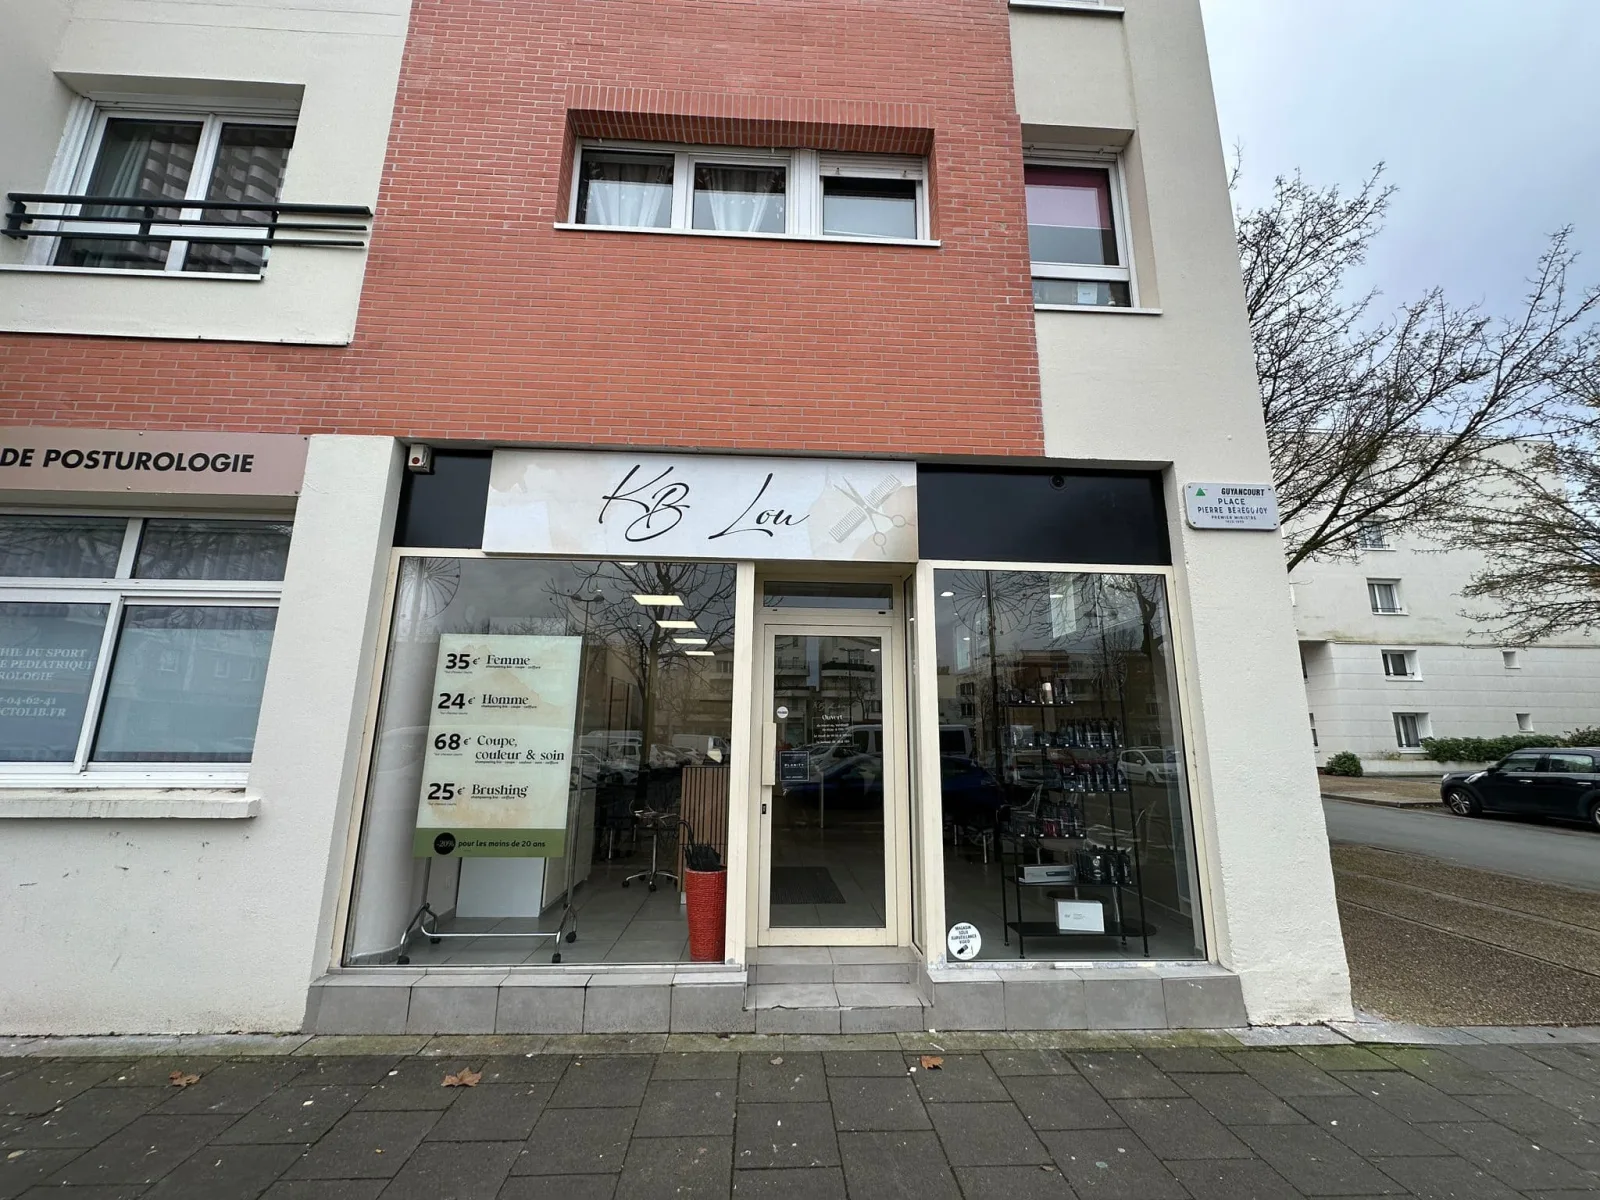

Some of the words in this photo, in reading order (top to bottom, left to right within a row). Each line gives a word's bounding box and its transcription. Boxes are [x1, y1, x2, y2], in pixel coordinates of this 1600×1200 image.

[0, 448, 35, 467] DE
[43, 449, 254, 473] POSTUROLOGIE
[1221, 487, 1265, 496] GUYANCOURT
[598, 464, 690, 542] KB
[707, 472, 810, 540] Lou
[1197, 506, 1223, 514] PIERRE
[25, 648, 43, 657] DU
[45, 649, 87, 657] SPORT
[445, 653, 470, 670] 35
[486, 654, 530, 665] Femme
[0, 696, 56, 706] -04-62-41
[438, 693, 465, 709] 24
[482, 694, 529, 705] Homme
[434, 733, 461, 750] 68
[477, 735, 517, 748] Coupe,
[475, 750, 522, 760] couleur
[526, 749, 535, 760] &
[540, 750, 565, 760] soin
[427, 783, 454, 800] 25
[472, 784, 528, 798] Brushing
